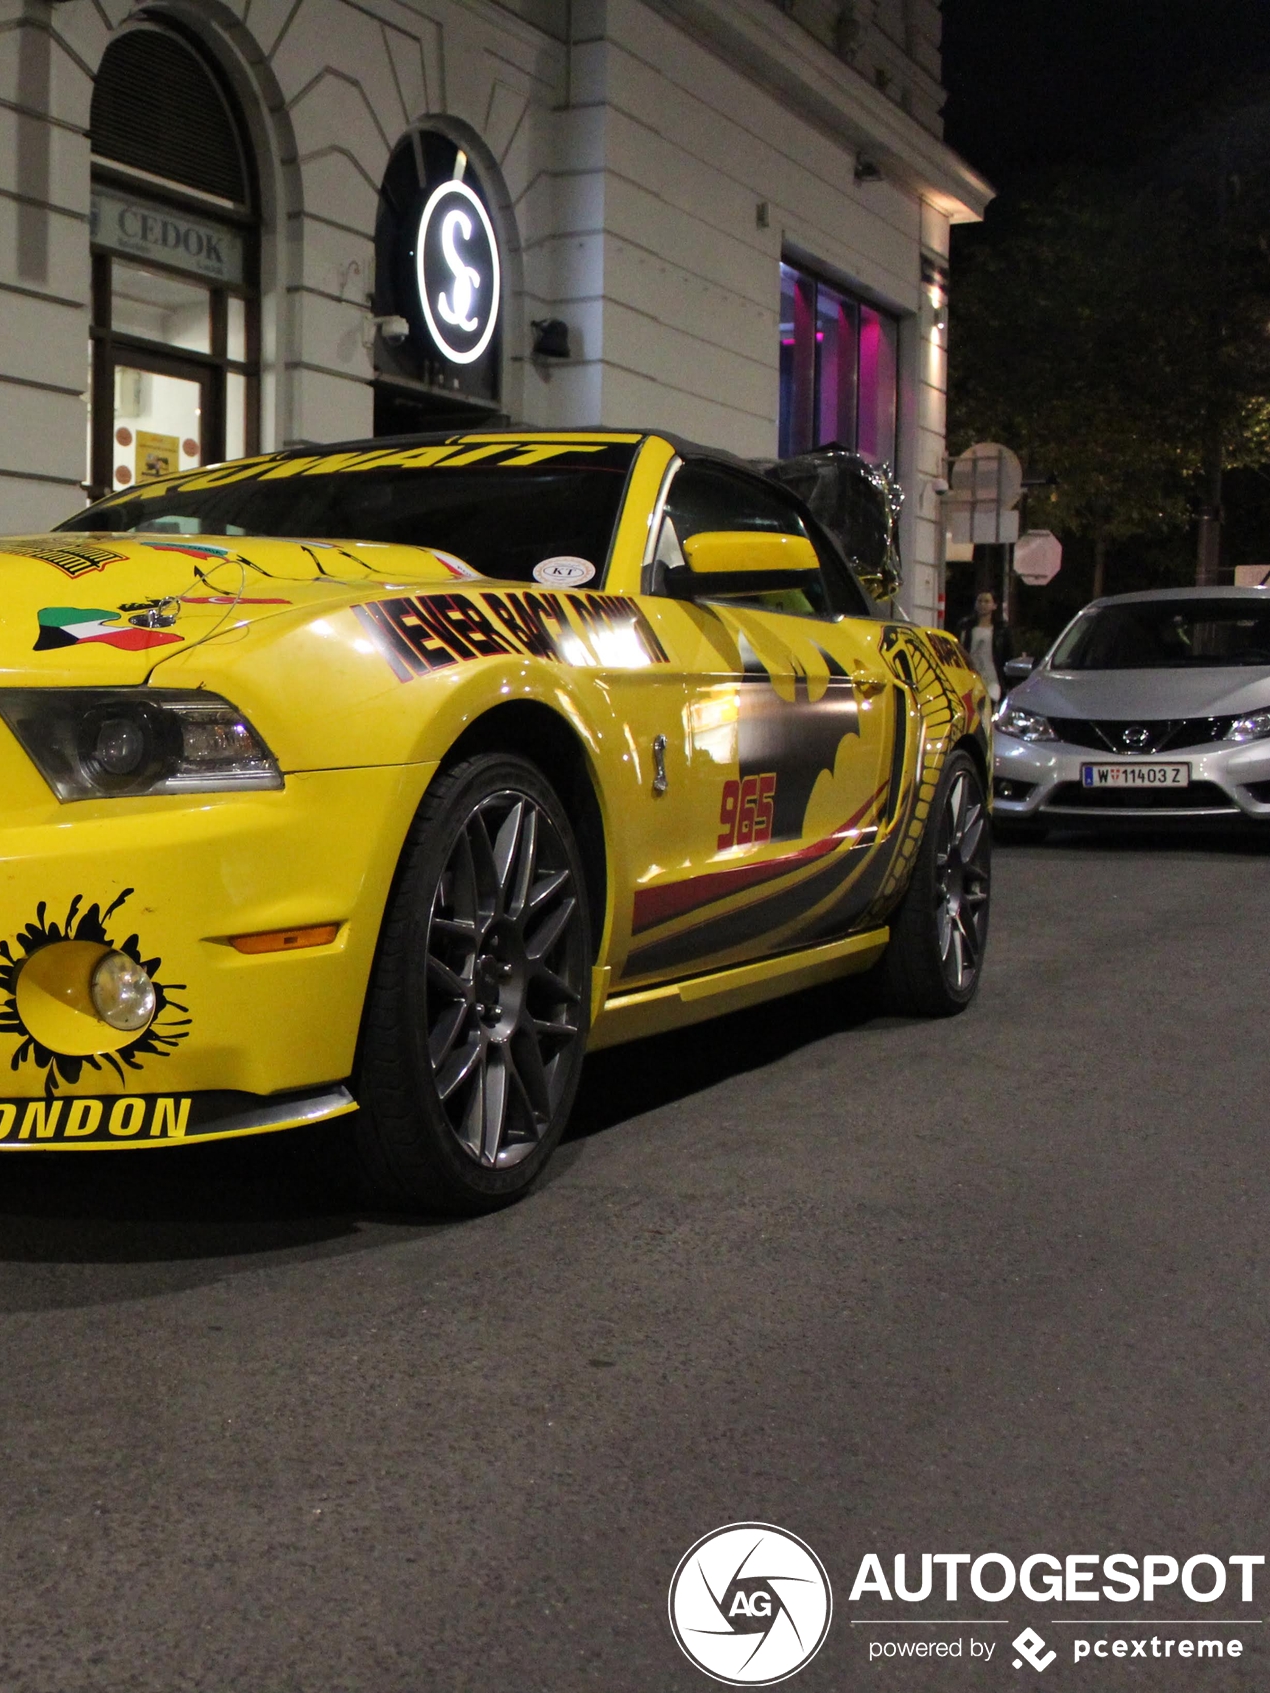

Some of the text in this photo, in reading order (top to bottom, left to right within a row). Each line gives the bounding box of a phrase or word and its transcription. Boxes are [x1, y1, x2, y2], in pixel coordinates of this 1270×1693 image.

[350, 592, 524, 684] NEVER
[479, 591, 598, 667] BACK
[717, 772, 776, 850] 965
[1097, 768, 1109, 783] W
[1121, 768, 1167, 783] 11403
[1171, 768, 1180, 783] Z
